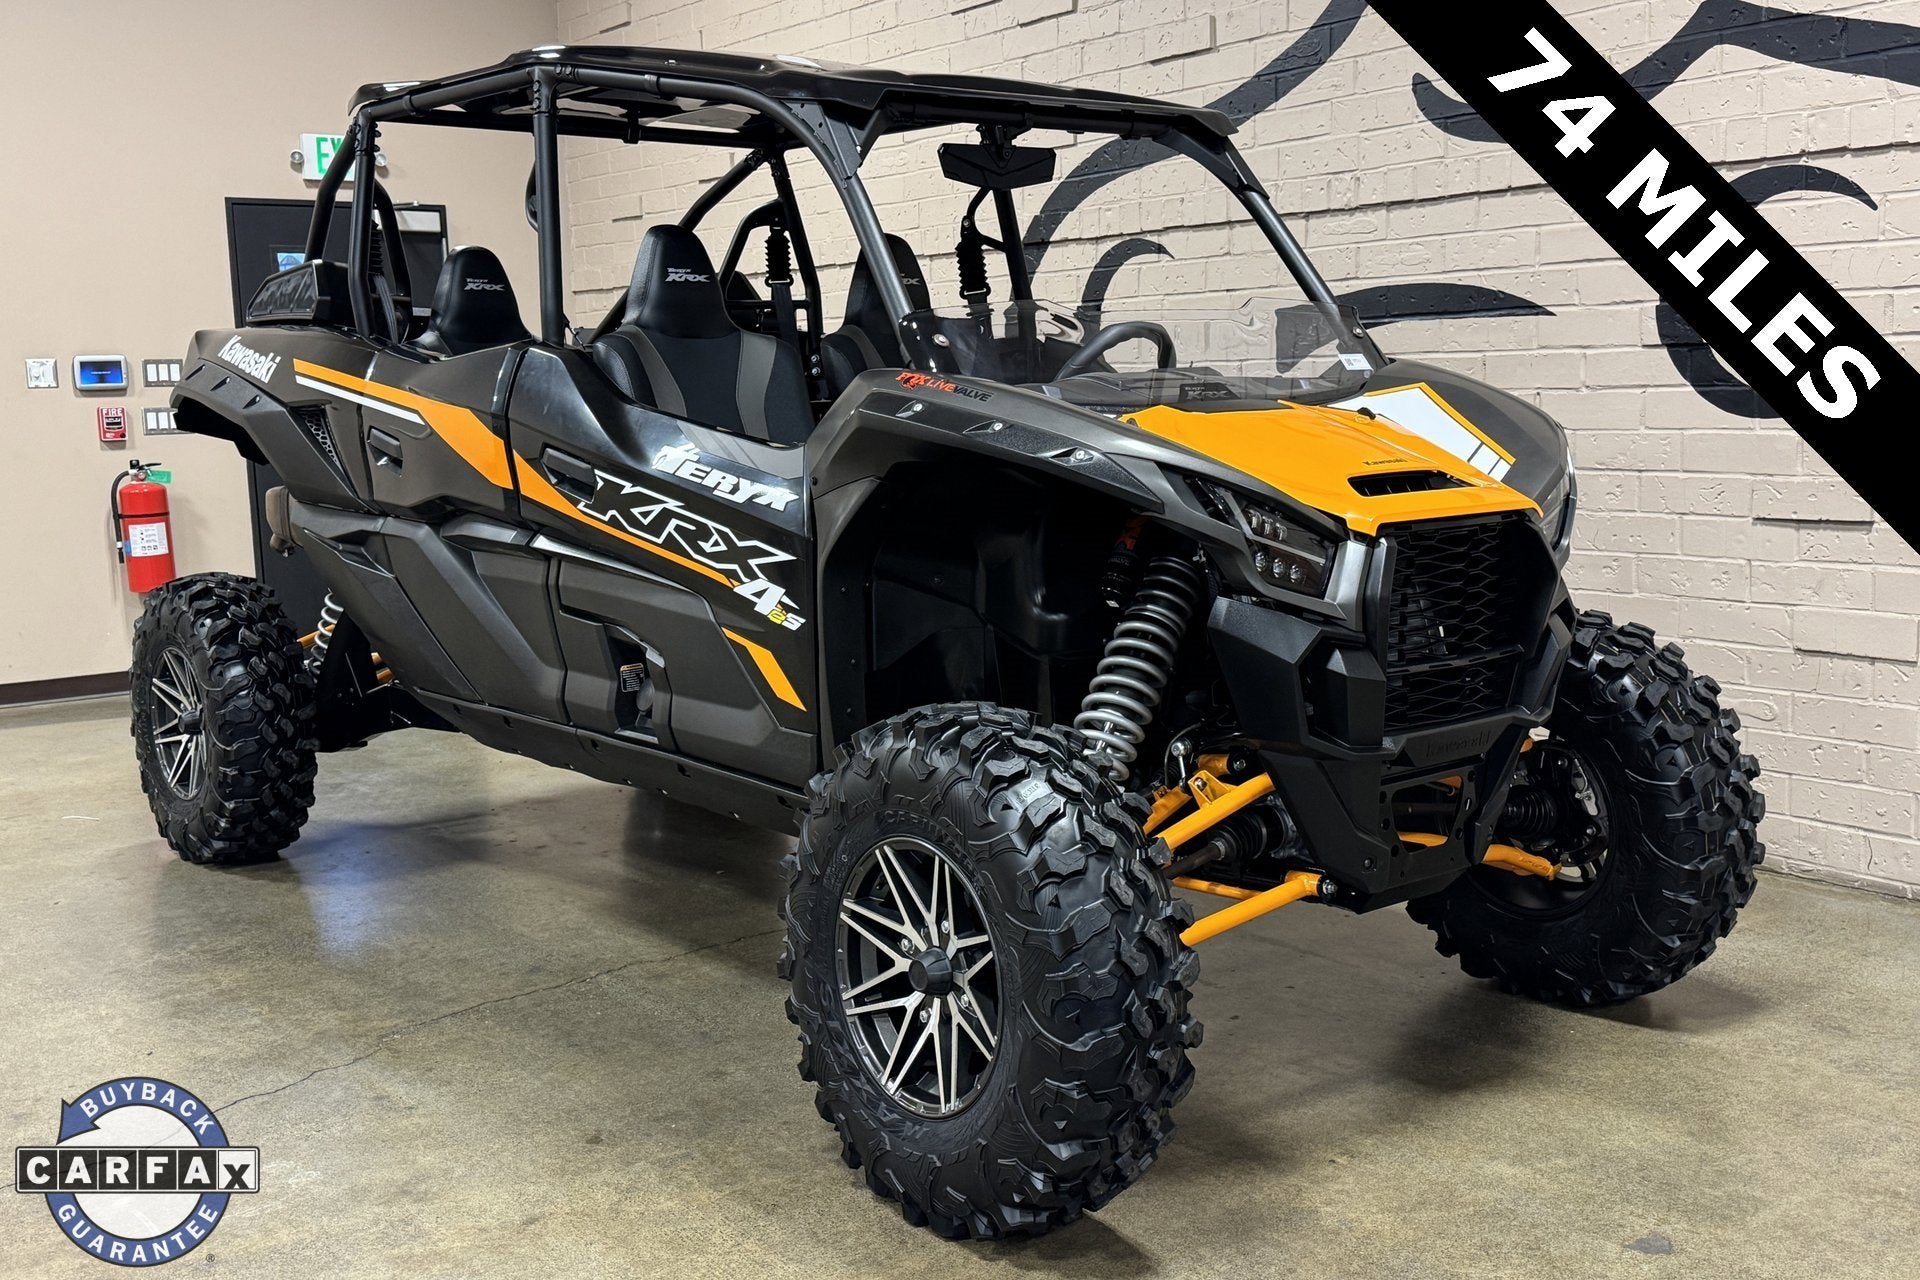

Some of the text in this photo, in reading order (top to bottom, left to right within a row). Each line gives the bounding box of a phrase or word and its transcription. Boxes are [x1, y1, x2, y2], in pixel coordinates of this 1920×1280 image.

[664, 272, 711, 282] KRX
[463, 283, 505, 291] KRX
[217, 334, 281, 384] Kawasaki
[102, 408, 123, 417] FIRE
[576, 468, 797, 583] KRX
